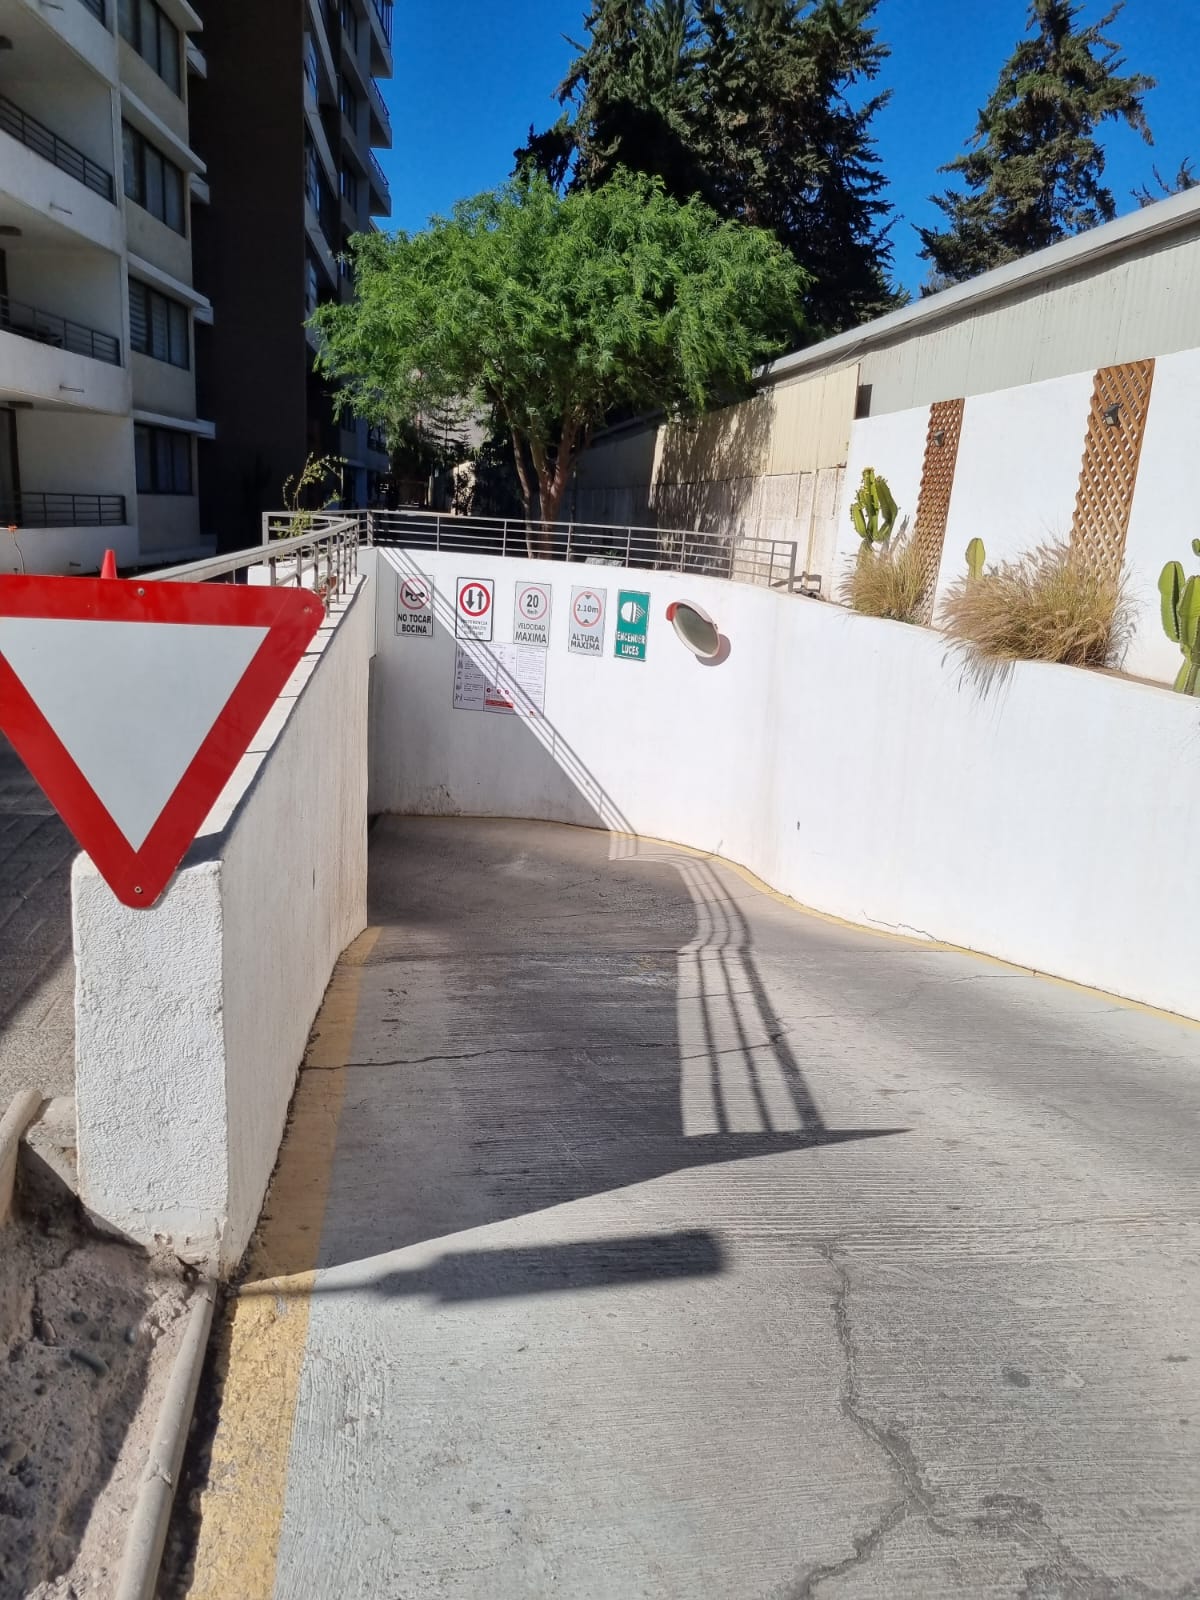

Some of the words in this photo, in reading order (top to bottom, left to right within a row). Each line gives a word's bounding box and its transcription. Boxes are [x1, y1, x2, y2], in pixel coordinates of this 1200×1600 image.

[526, 594, 539, 608] 20
[576, 604, 599, 614] 2.10m
[397, 613, 408, 622] NO
[410, 614, 432, 624] TOCAR
[401, 624, 427, 634] BOCINA
[518, 622, 546, 631] VELOCIDAD
[515, 631, 547, 644] MAXIMA
[572, 633, 600, 643] ALTURA
[570, 640, 600, 651] MAXIMA
[621, 644, 640, 656] LUCES
